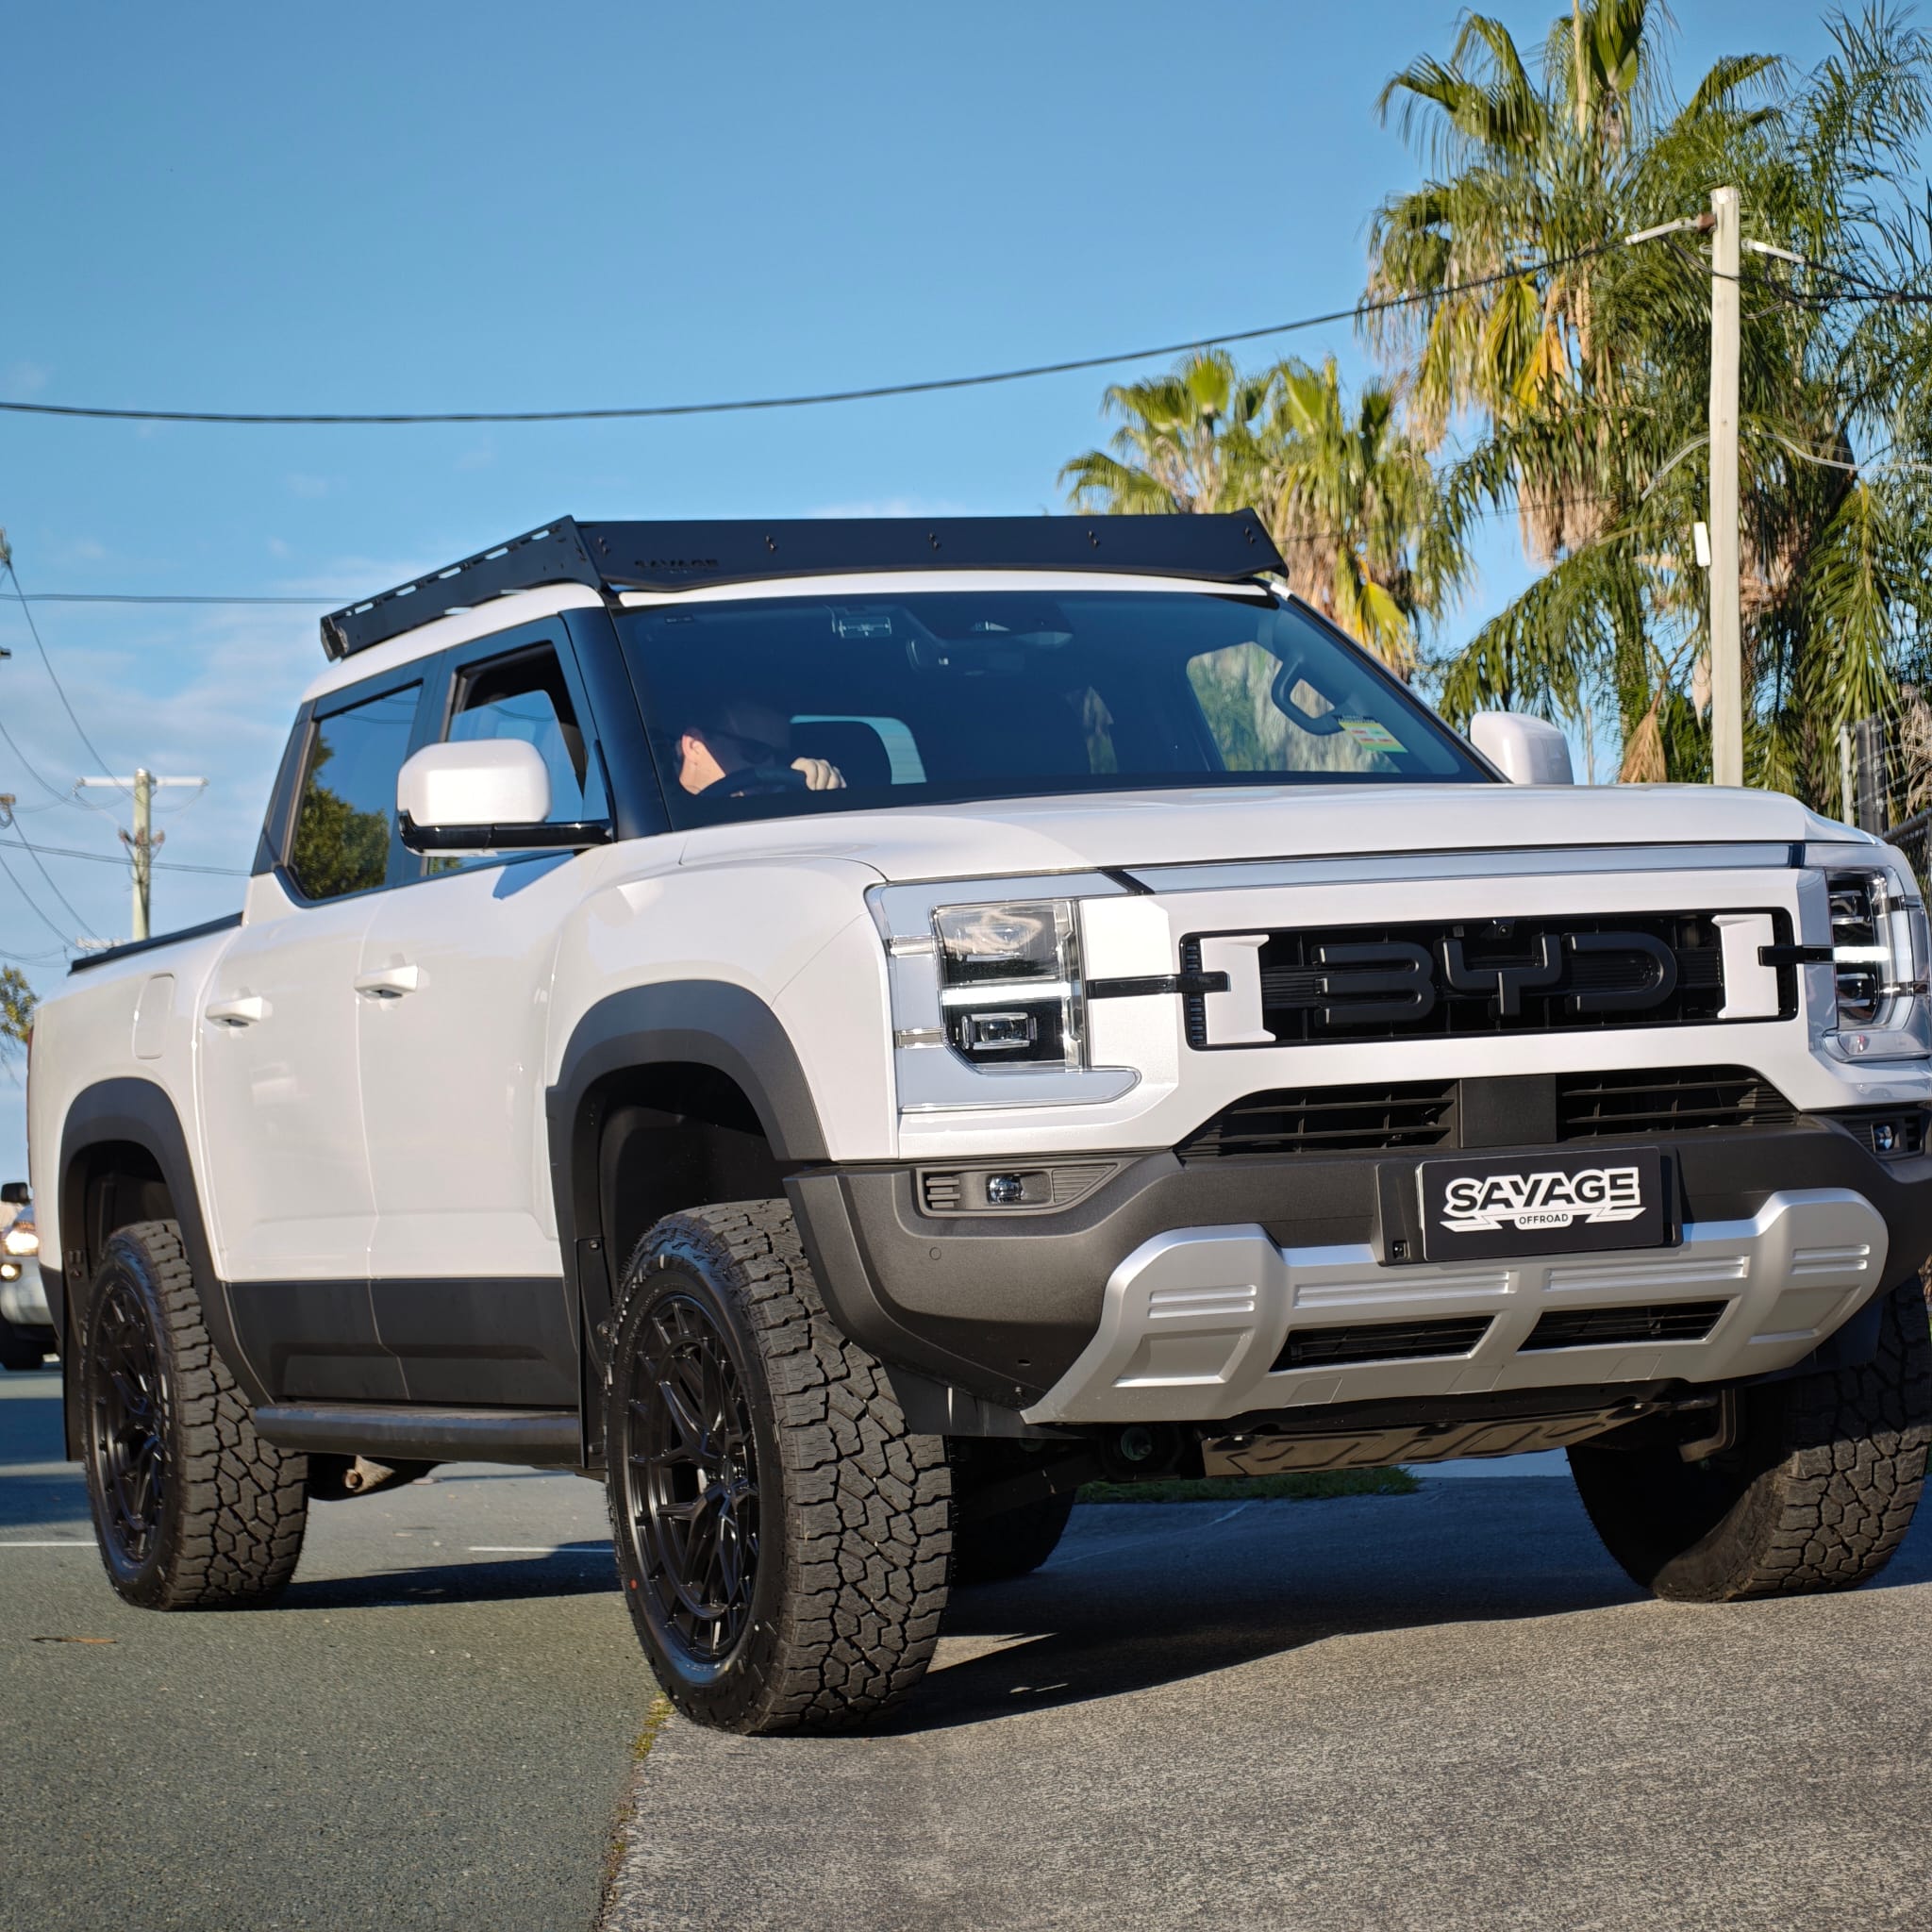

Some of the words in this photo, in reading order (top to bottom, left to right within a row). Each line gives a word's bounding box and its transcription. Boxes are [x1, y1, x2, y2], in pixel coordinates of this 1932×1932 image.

[1313, 932, 1678, 1026] BYD
[1449, 1170, 1640, 1213] SAVAGE
[1519, 1213, 1569, 1225] OFFROAD
